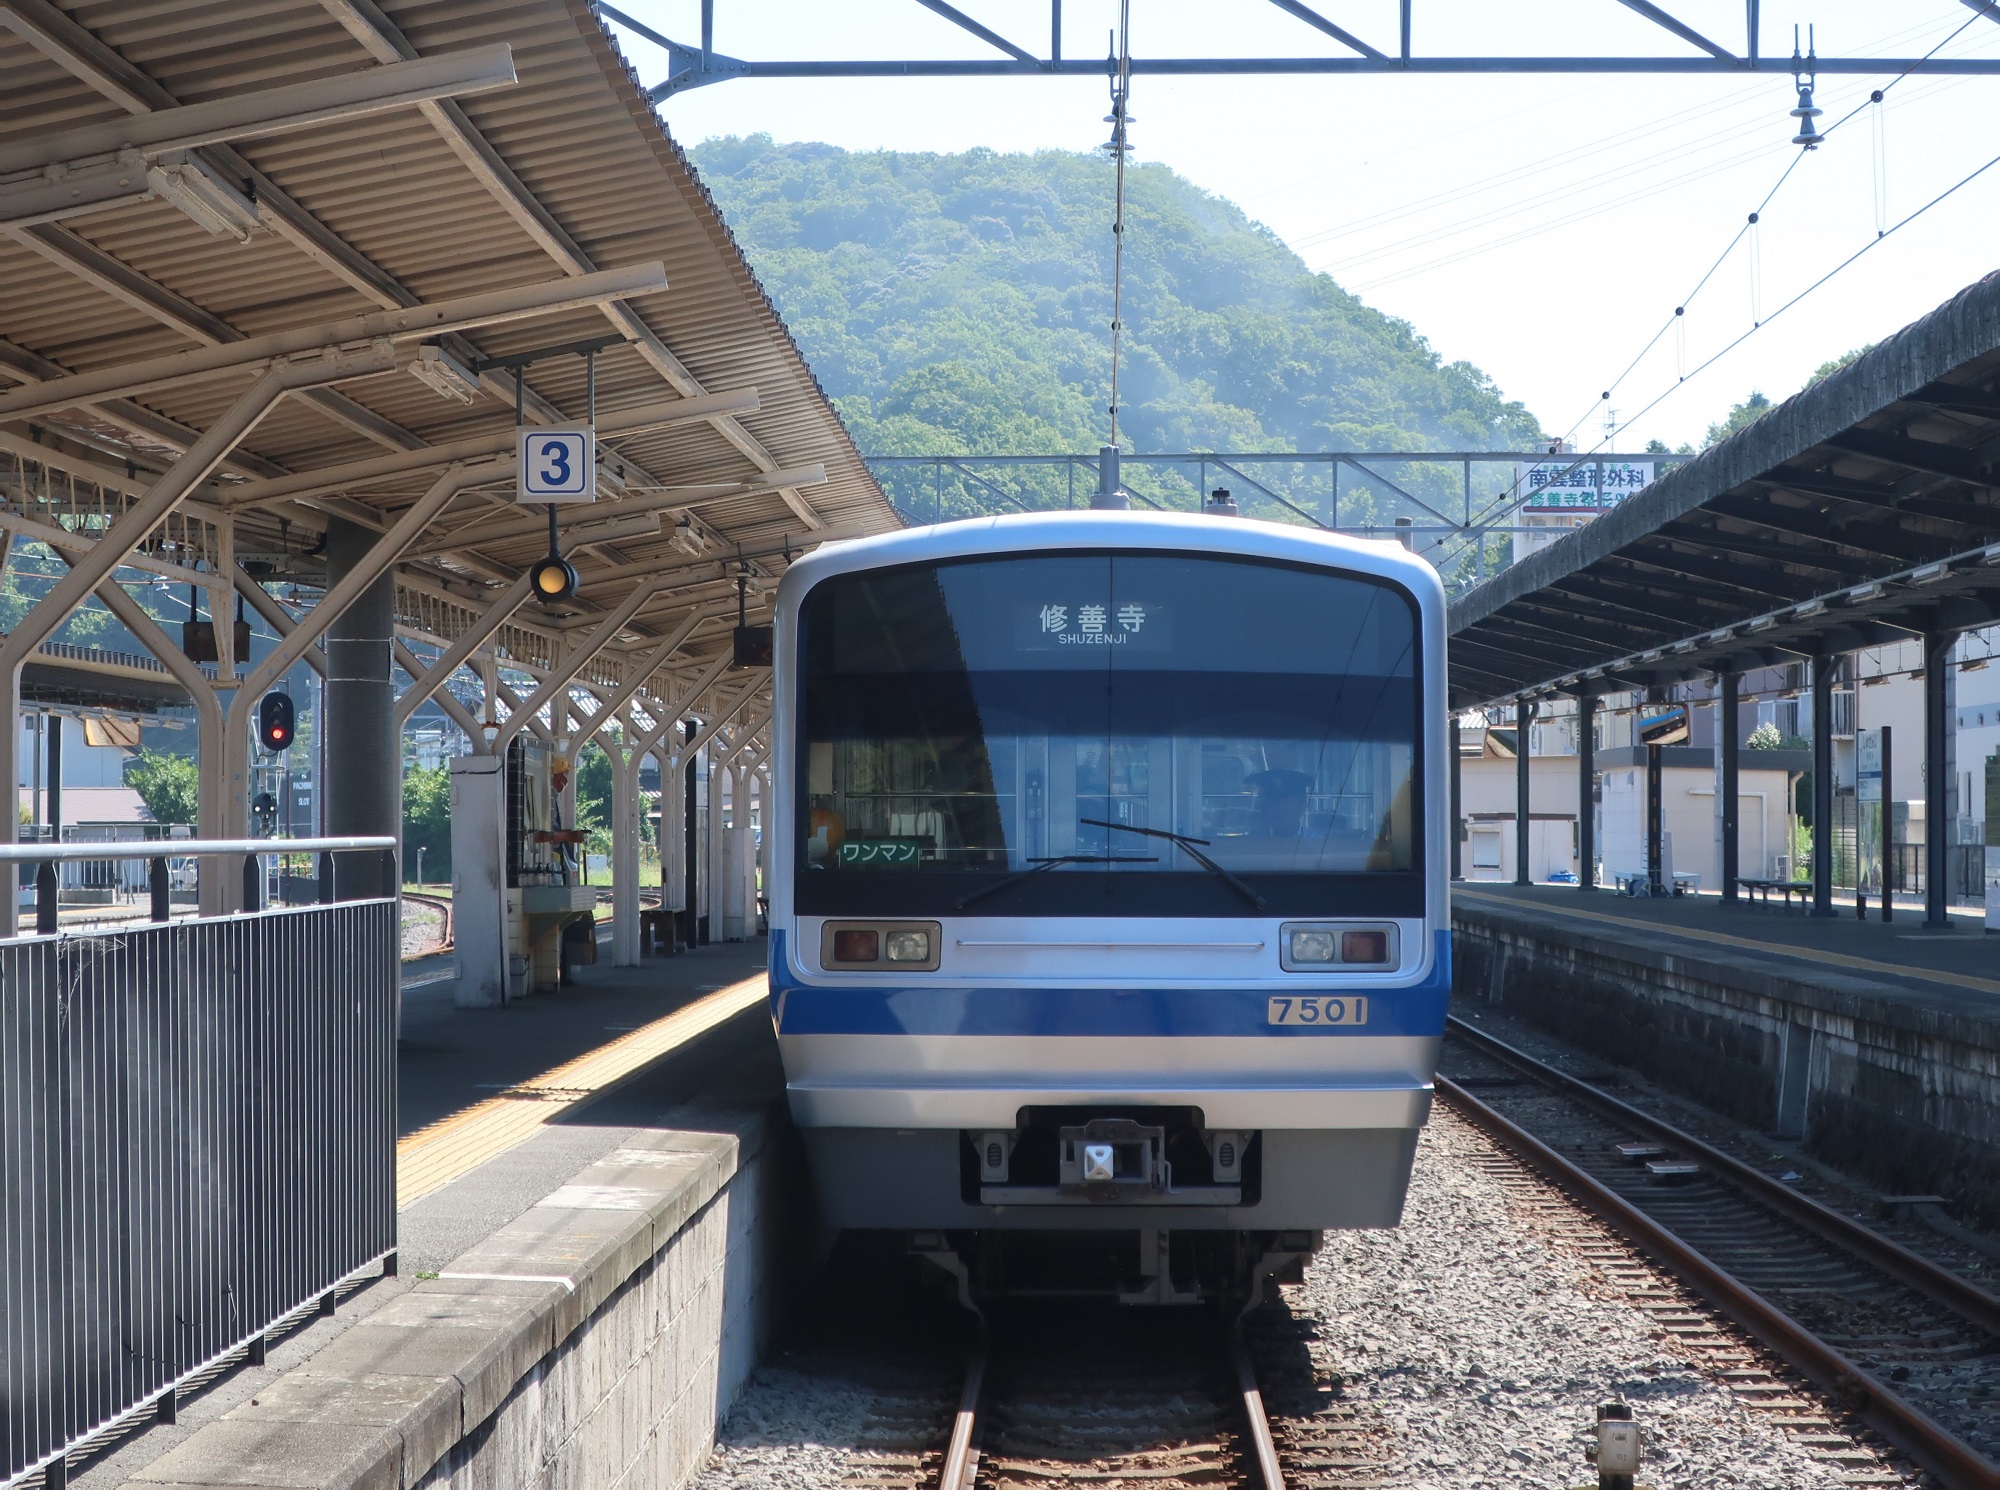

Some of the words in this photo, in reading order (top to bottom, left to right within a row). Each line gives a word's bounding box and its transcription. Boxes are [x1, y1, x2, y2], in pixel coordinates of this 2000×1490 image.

[540, 441, 571, 486] 3
[1039, 604, 1146, 633] 修善寺
[1058, 633, 1127, 644] SHUZENJI
[297, 797, 310, 806] SLOT
[843, 844, 915, 861] ワンマン
[1272, 998, 1363, 1023] 7501
